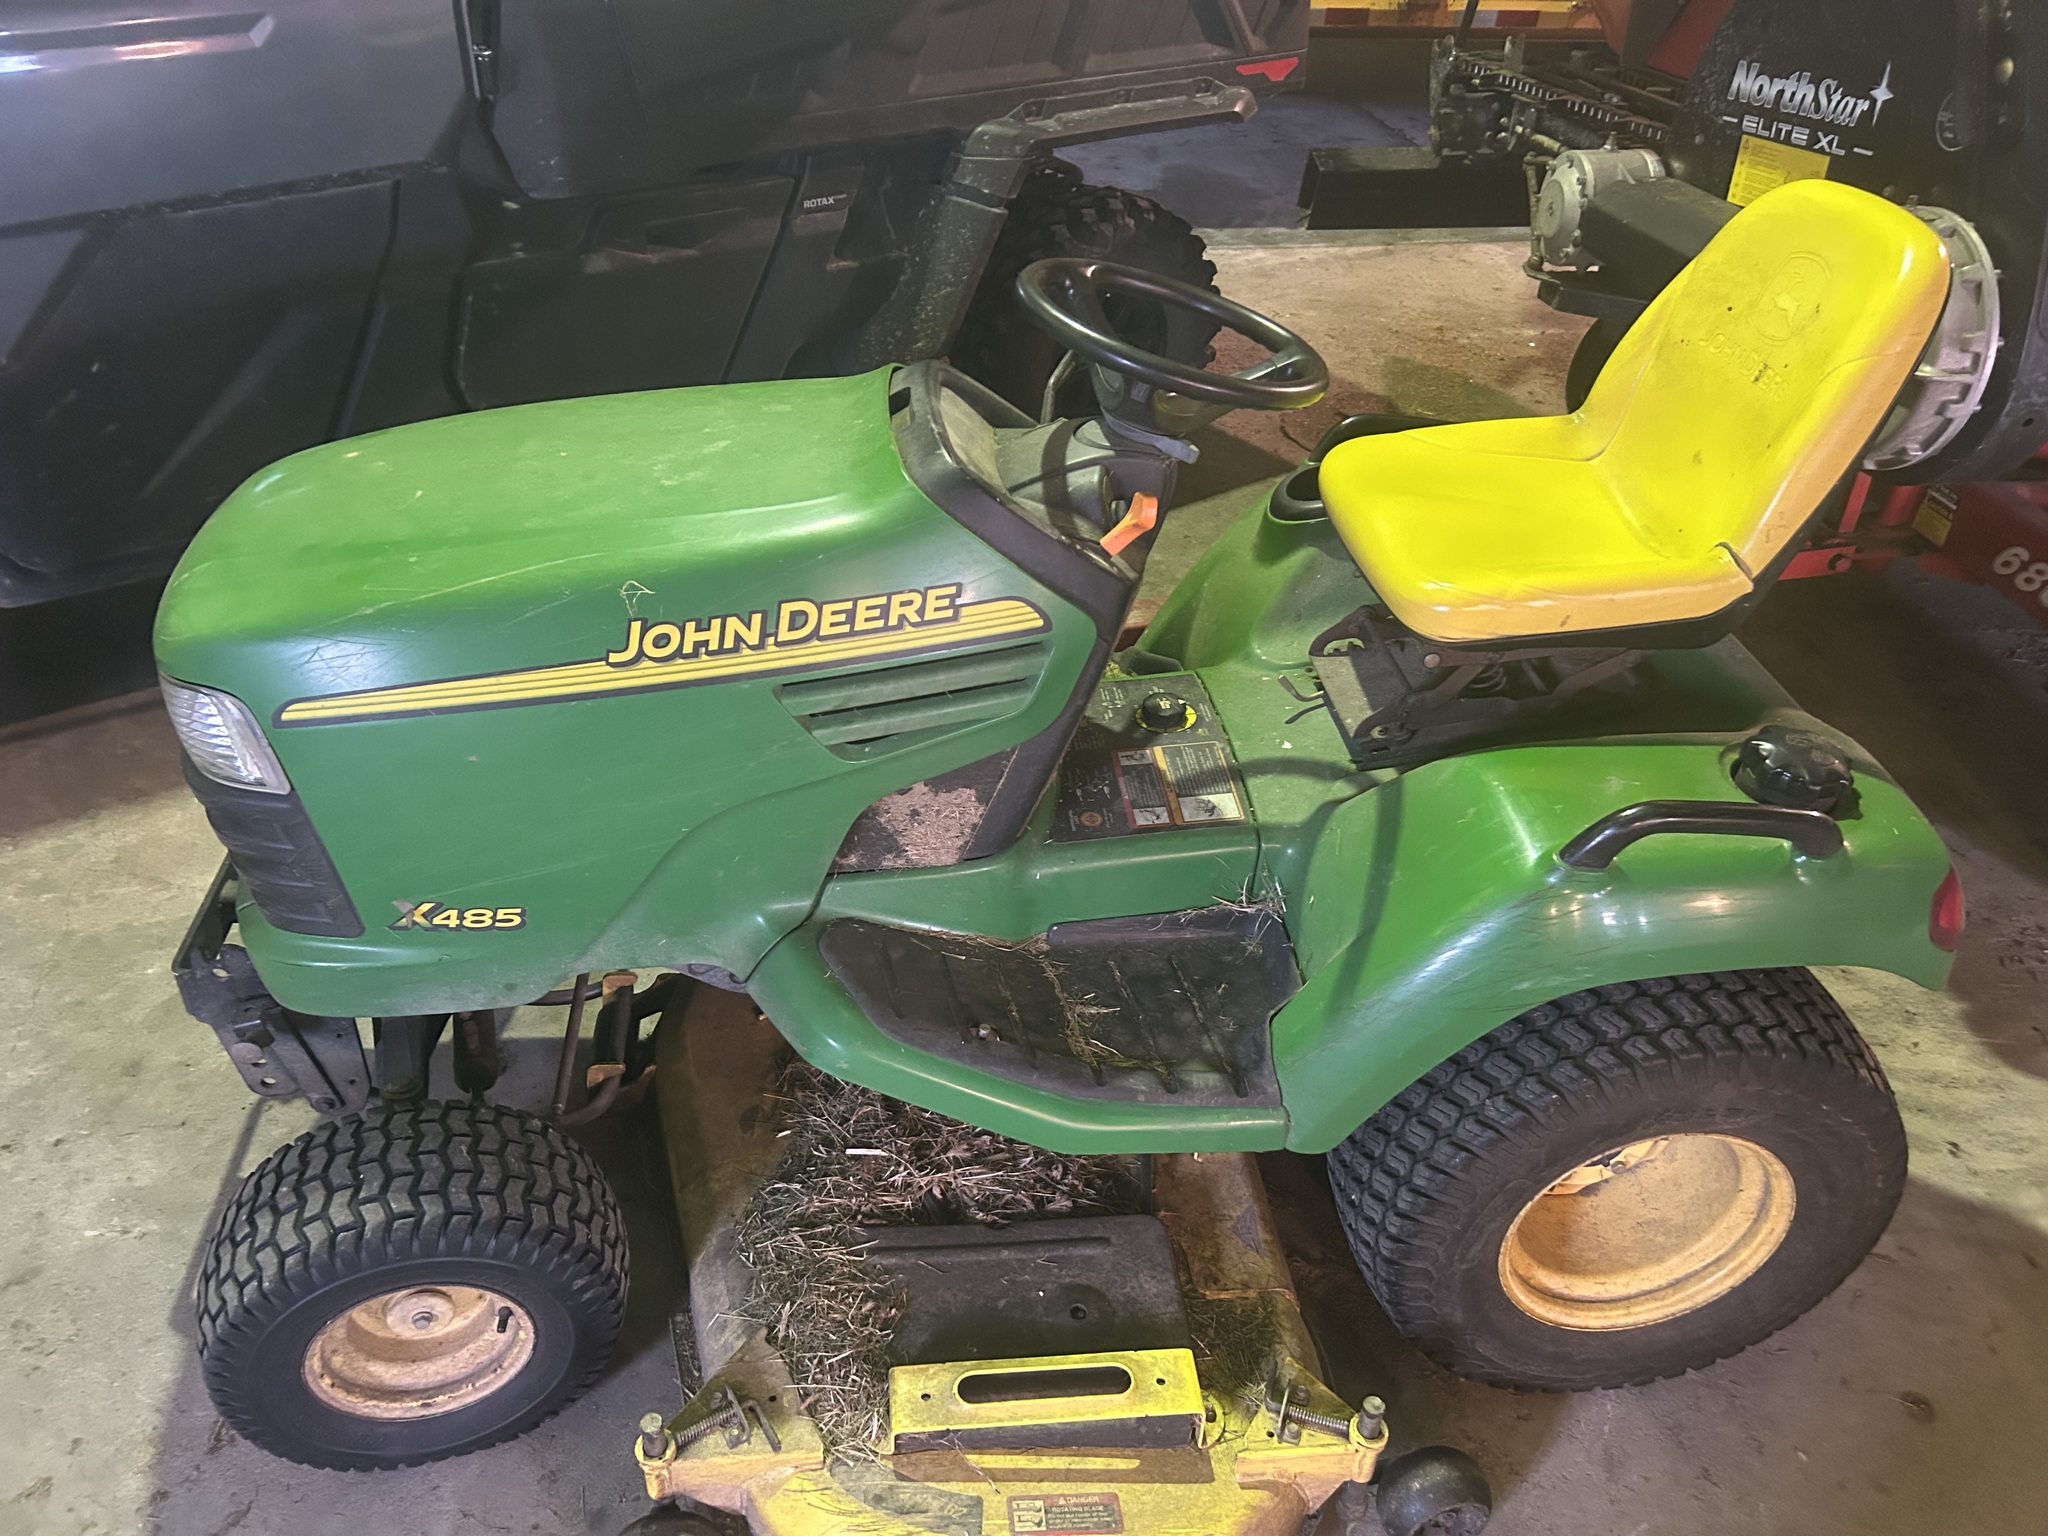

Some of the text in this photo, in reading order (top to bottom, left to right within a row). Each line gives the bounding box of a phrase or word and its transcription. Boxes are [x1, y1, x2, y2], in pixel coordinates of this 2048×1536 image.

[1726, 60, 1869, 127] NorthStar
[1742, 114, 1846, 156] ELITE XL
[803, 195, 835, 208] ROTAX
[606, 583, 962, 667] JOHN DEERE
[387, 900, 527, 932] X485
[1066, 1495, 1100, 1504] DANGER
